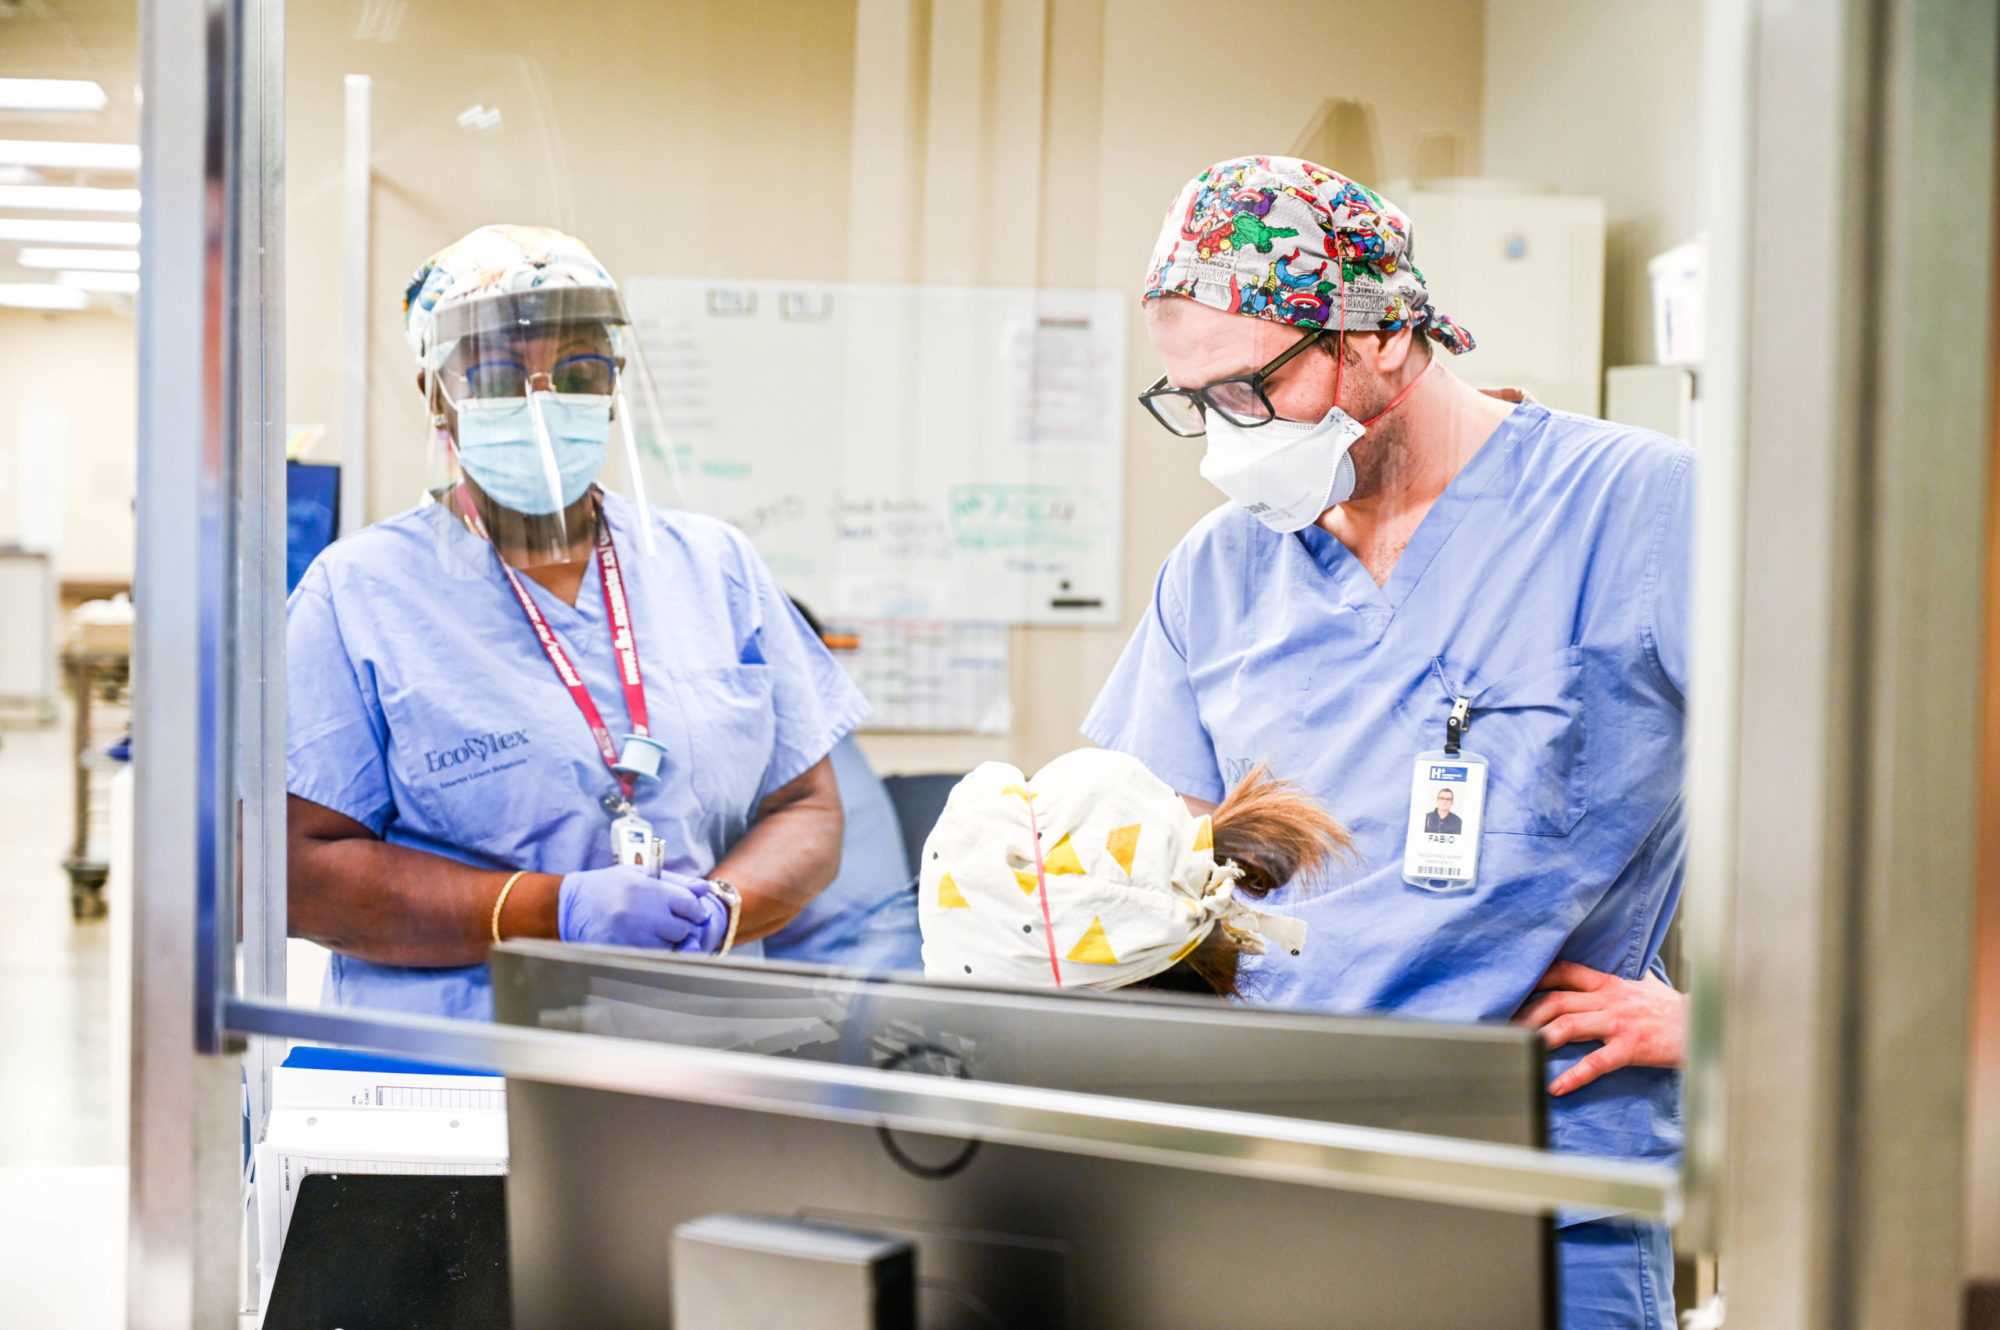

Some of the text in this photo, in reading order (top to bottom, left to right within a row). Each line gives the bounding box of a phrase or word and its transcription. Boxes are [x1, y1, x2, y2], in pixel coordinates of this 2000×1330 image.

[1347, 286, 1385, 295] COMICS
[1344, 294, 1389, 310] MARVEL
[424, 729, 530, 773] EcoTex
[1428, 834, 1455, 844] FABIO
